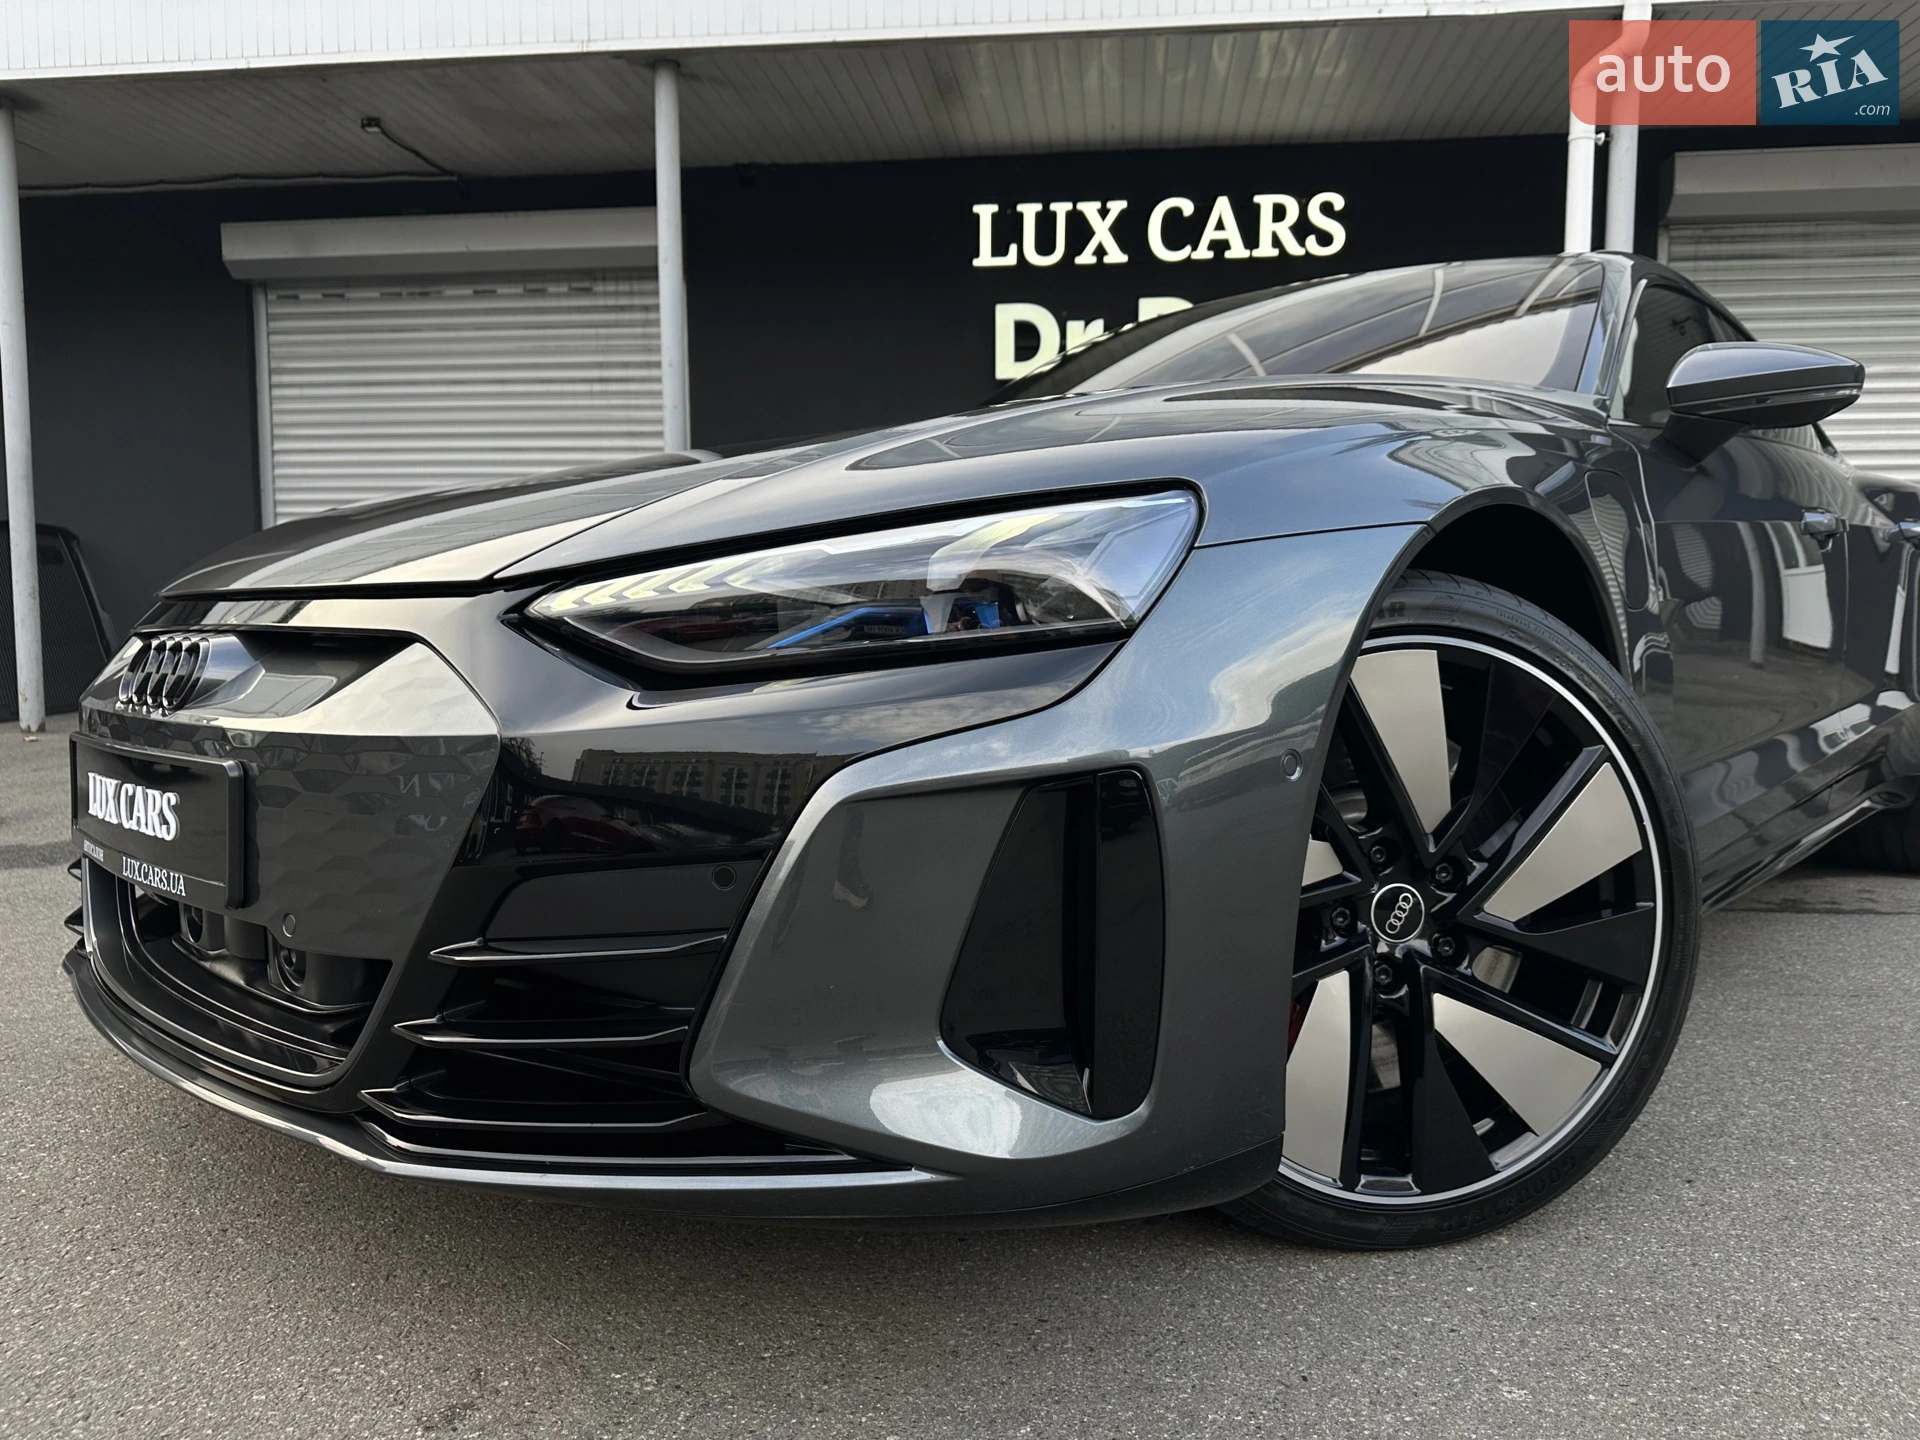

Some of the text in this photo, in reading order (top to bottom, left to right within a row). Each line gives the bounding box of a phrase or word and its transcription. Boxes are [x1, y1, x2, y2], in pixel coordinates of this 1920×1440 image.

[972, 191, 1347, 267] LUX CARS
[87, 772, 180, 842] LUX CARS
